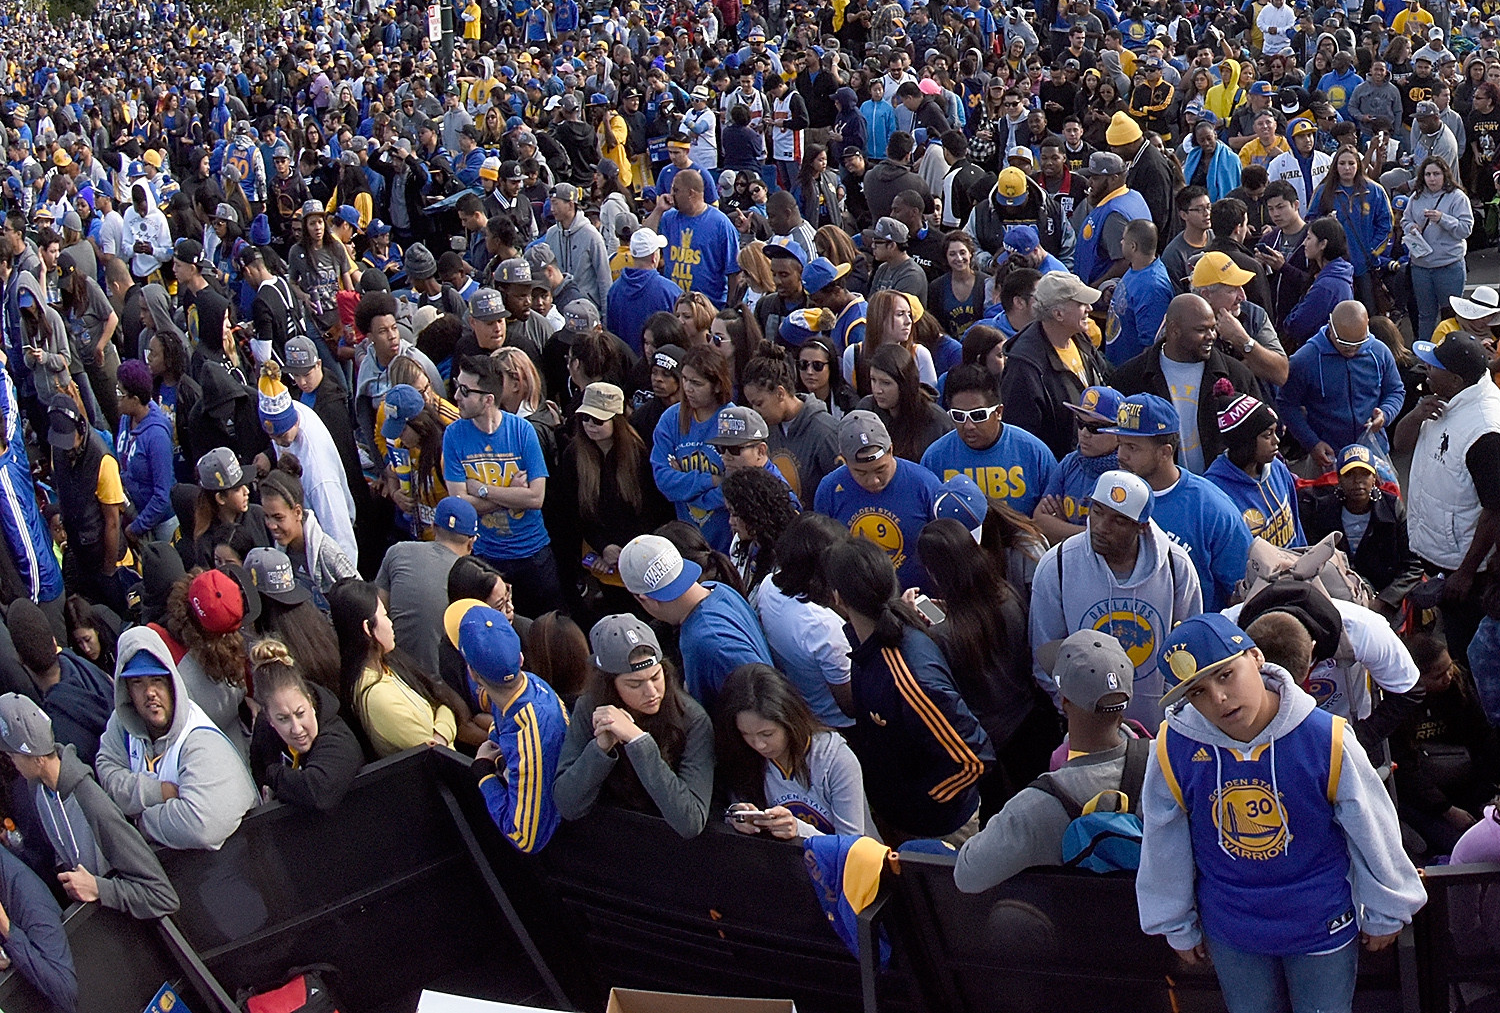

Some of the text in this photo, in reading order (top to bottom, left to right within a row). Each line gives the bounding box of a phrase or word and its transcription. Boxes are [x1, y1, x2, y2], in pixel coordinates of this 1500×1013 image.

[670, 248, 701, 265] DUBS
[672, 263, 692, 279] ALL
[462, 461, 523, 488] NBA
[848, 507, 903, 526] GOLDEN STATE
[876, 524, 887, 538] 9
[1164, 643, 1186, 663] CITY
[803, 795, 829, 817] STATE
[1246, 798, 1273, 819] 30
